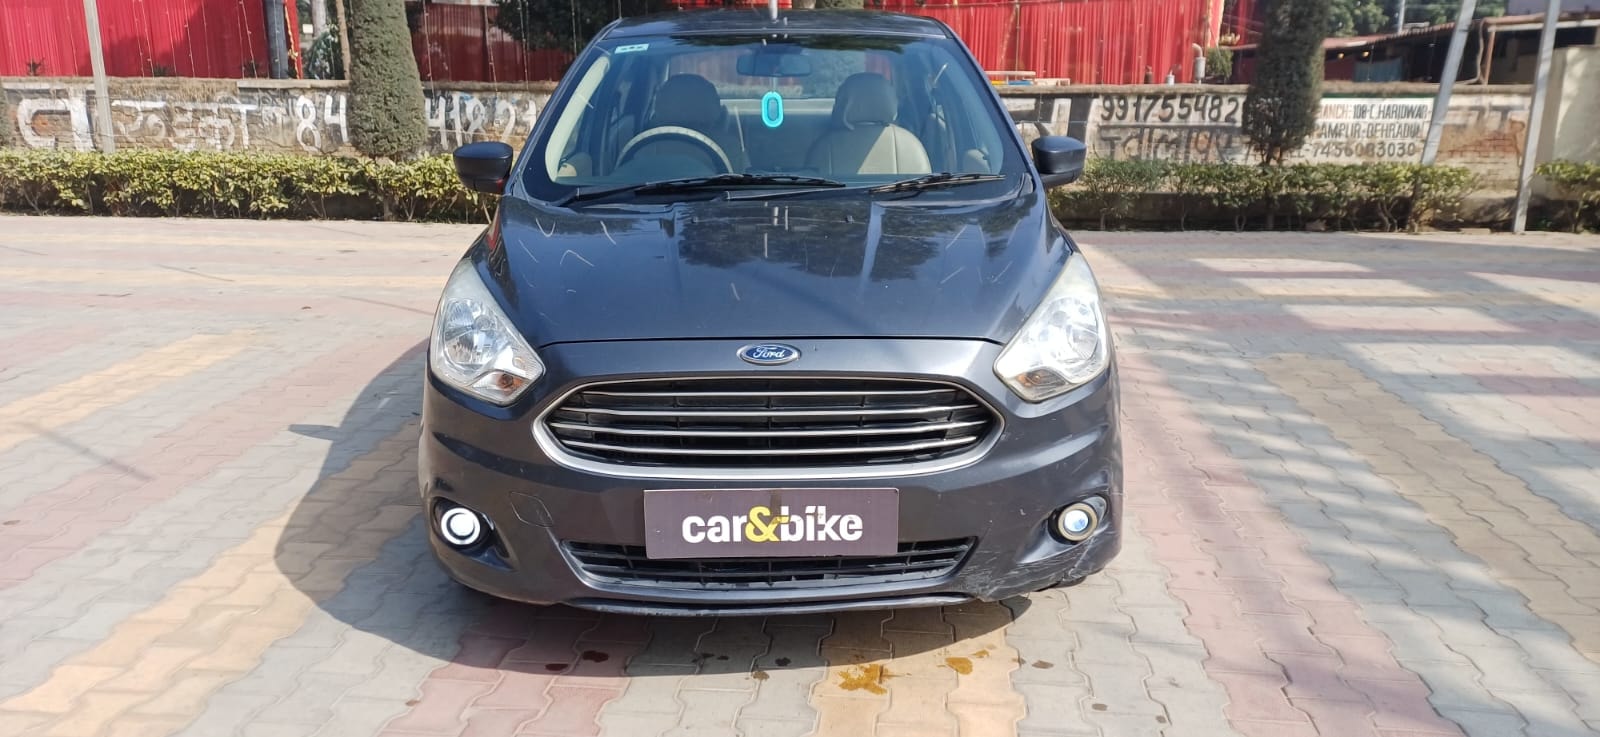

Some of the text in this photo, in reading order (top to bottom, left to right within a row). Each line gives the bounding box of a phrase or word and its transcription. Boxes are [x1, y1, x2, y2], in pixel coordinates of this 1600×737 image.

[1100, 94, 1240, 123] 991755482
[752, 346, 786, 358] Ford
[682, 505, 863, 544] car&bike
